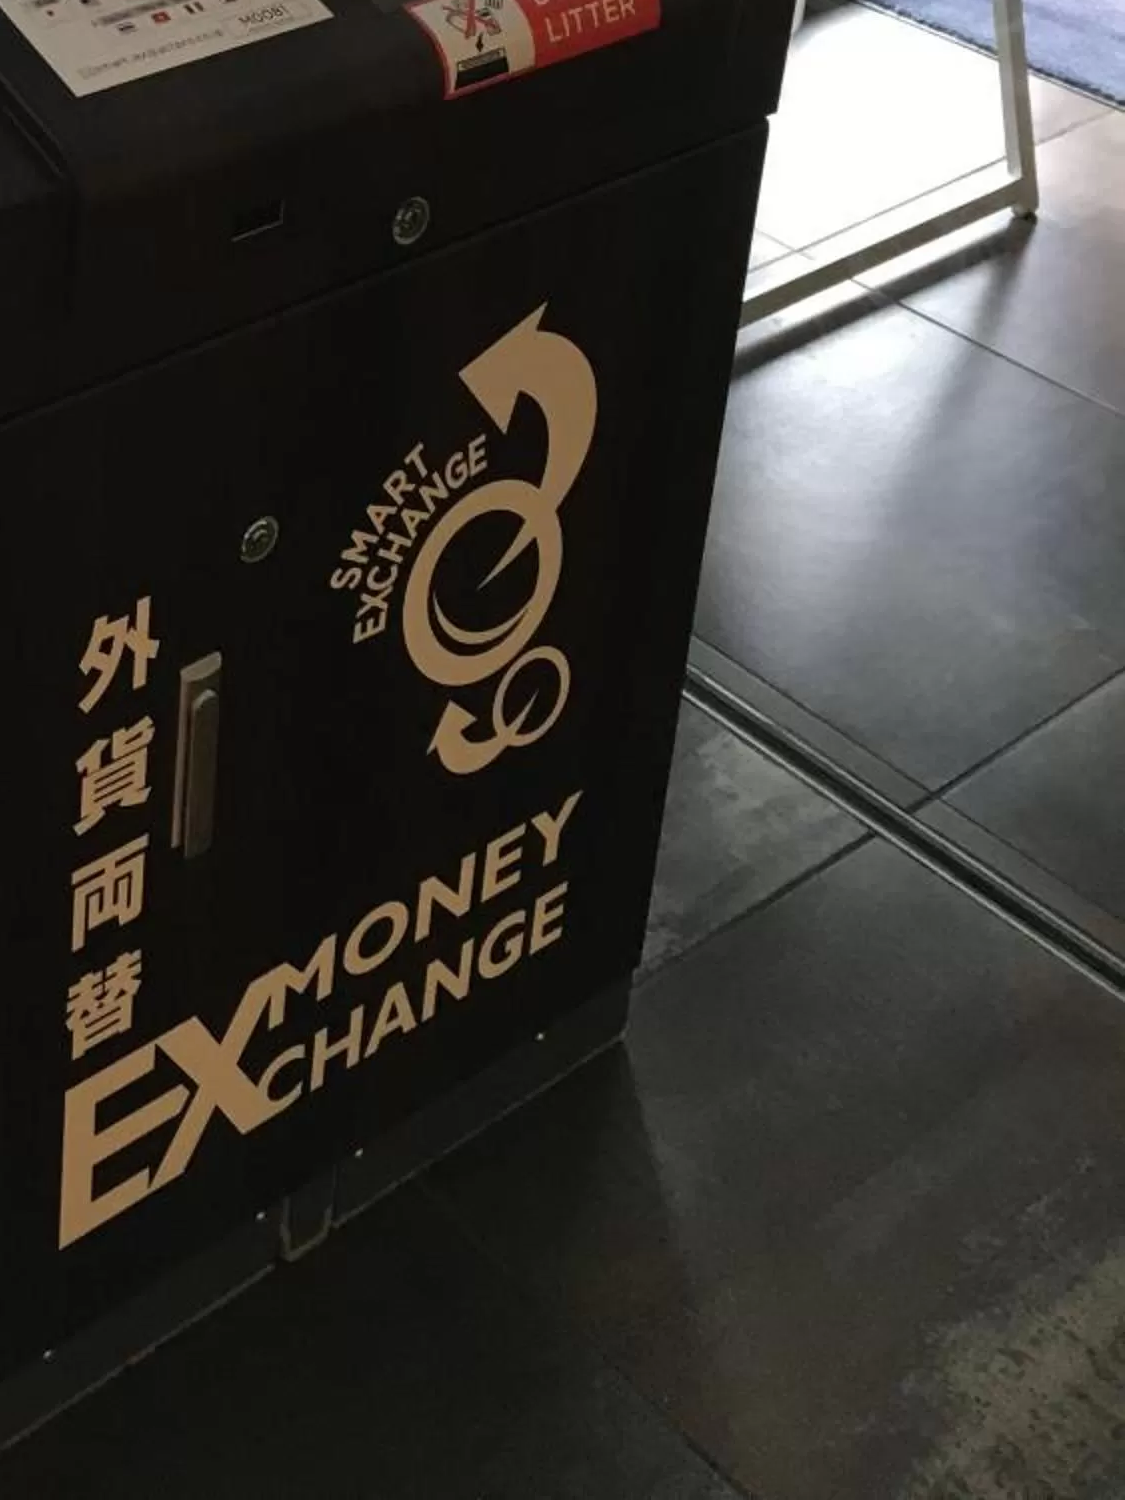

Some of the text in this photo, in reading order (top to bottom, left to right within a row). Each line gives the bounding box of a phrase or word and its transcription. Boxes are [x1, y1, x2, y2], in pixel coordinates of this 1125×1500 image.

[330, 441, 429, 591] SMART
[352, 433, 488, 644] EXCHANGE
[63, 595, 161, 1063] 外貨両替
[265, 789, 584, 1028] MONEY
